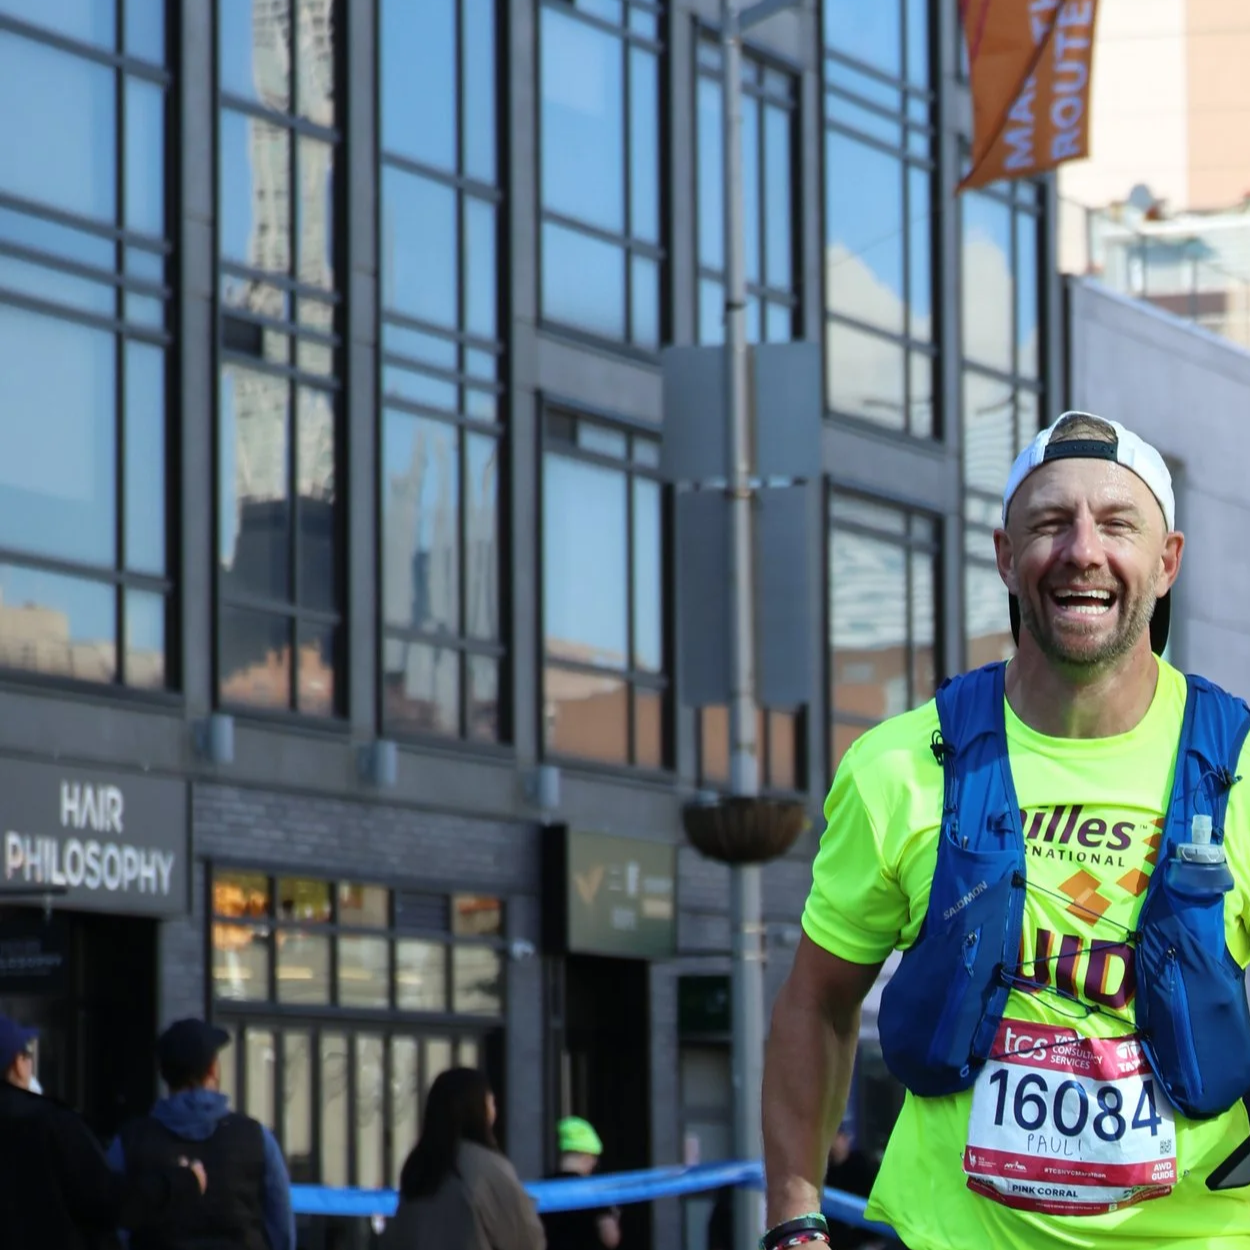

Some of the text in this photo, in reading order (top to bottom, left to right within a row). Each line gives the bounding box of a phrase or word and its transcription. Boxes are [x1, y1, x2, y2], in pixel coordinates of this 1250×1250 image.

[1050, 0, 1092, 160] ROUTE
[60, 779, 125, 834] HAIR
[5, 829, 175, 896] PHILOSOPHY
[943, 880, 988, 920] SALOMON
[1004, 1027, 1048, 1061] tcs
[1050, 1056, 1091, 1070] SERVICES
[989, 1068, 1162, 1143] 16084
[1026, 1133, 1083, 1161] PAUL!
[1151, 1170, 1175, 1181] GUIDE
[1153, 1161, 1172, 1172] AWD
[1012, 1184, 1035, 1194] PINK
[1037, 1186, 1079, 1198] CORRAL
